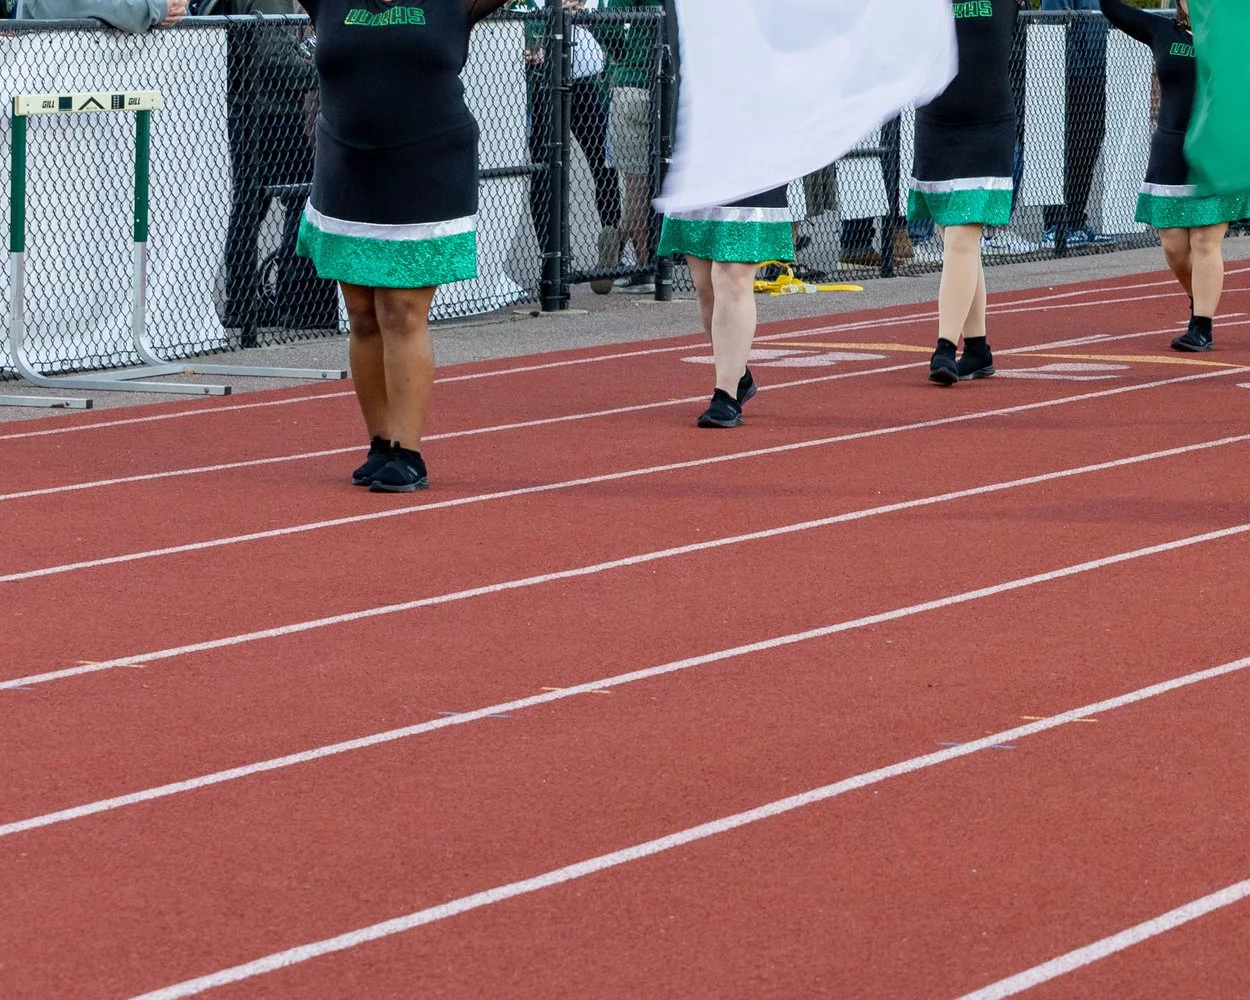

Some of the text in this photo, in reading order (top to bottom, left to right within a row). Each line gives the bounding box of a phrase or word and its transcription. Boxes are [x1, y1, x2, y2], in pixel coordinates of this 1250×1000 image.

[344, 6, 426, 26] WKHS
[951, 0, 992, 18] KHS
[128, 97, 141, 105] GILL
